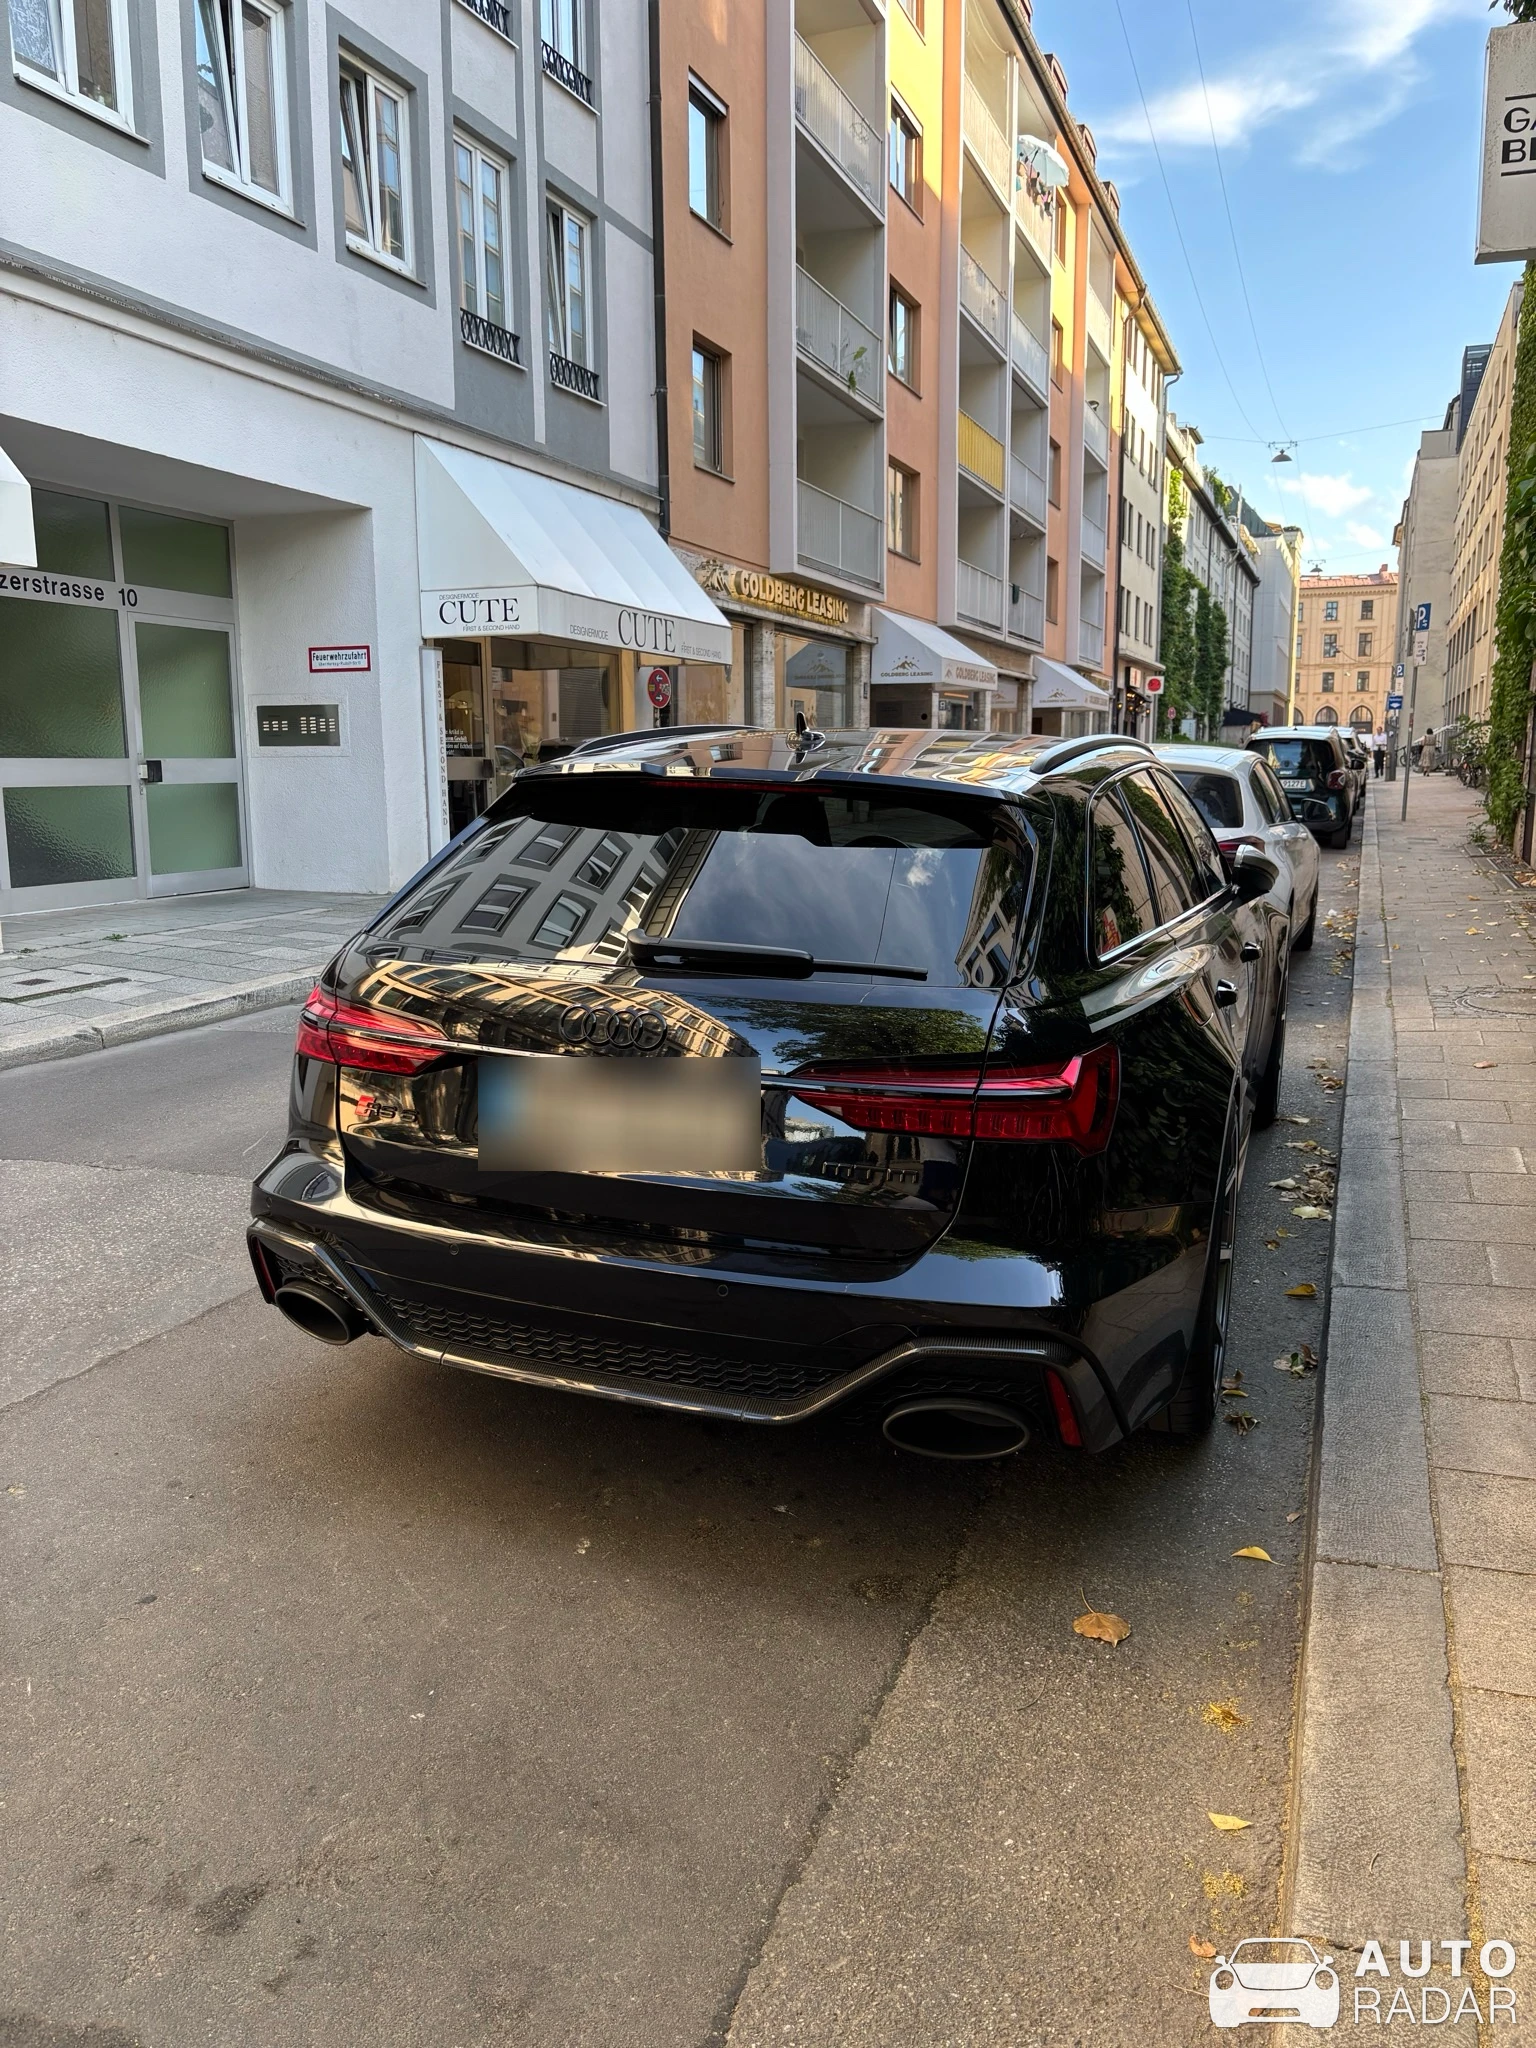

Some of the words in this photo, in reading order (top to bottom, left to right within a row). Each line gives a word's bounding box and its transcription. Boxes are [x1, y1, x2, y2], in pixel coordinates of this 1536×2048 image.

[118, 588, 138, 607] 10
[438, 592, 479, 600] DESIGNERMODE
[740, 570, 805, 611] GOLDBERG
[806, 591, 850, 624] LEASING
[439, 598, 520, 624] CUTE
[1417, 606, 1426, 629] P
[569, 624, 609, 640] DESIGNERMODE
[618, 609, 676, 653] CUTE
[312, 651, 367, 661] Feuerwehrzufahrt
[439, 727, 447, 784] SECOND
